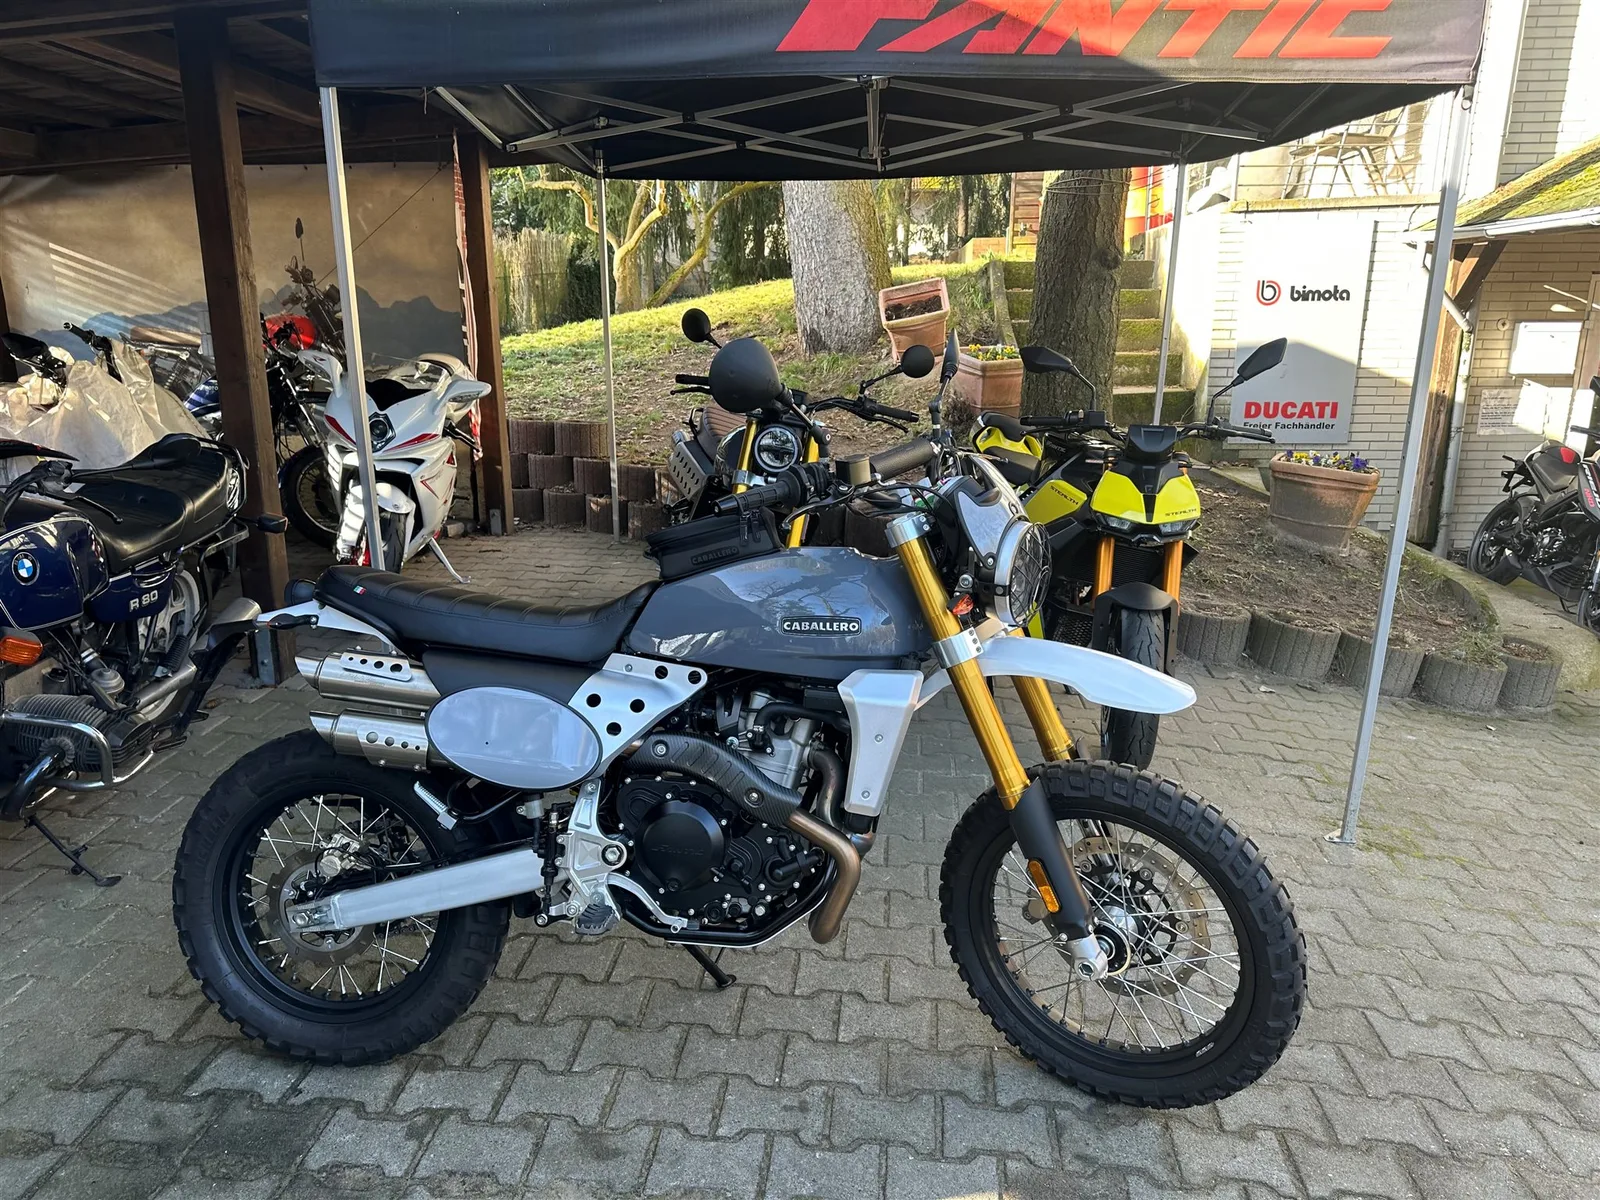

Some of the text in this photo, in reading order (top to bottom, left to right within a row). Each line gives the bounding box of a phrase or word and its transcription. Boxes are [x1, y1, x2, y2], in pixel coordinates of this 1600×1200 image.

[1290, 285, 1350, 302] bimota
[1244, 402, 1339, 419] DUCATI
[1275, 422, 1335, 430] Fachhändler
[1050, 485, 1079, 505] STEALTH
[1165, 508, 1197, 516] STEALTH
[692, 547, 738, 564] CABALLERO
[129, 590, 158, 612] R 80
[783, 621, 859, 632] CABALLERO
